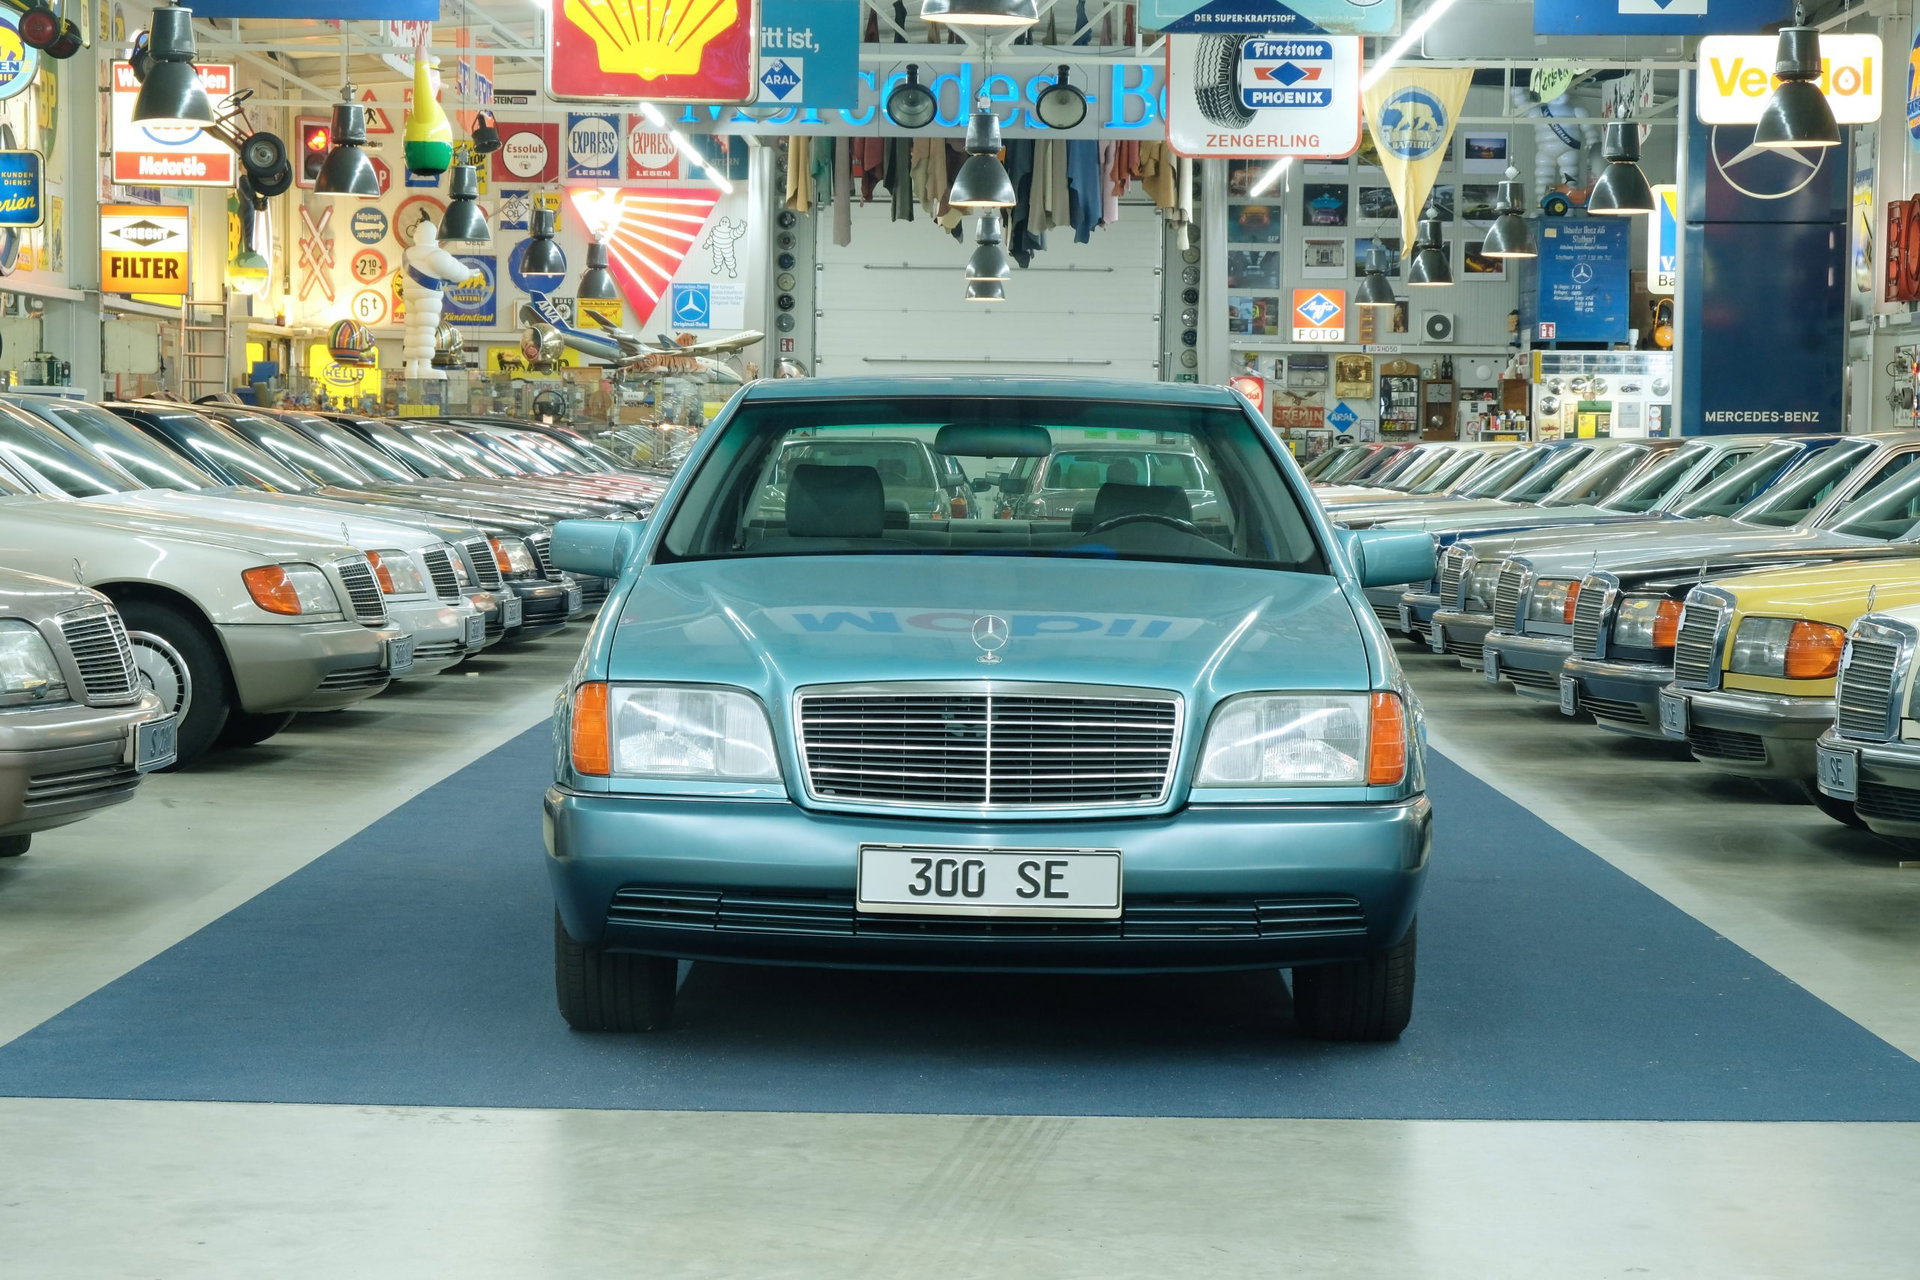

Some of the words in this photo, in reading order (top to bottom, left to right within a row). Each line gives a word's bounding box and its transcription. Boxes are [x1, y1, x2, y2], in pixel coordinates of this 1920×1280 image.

[1194, 14, 1212, 22] DER
[761, 27, 783, 48] itt
[787, 27, 820, 53] ist,
[1253, 41, 1323, 57] Firestone
[765, 75, 796, 85] ARAL
[1709, 57, 1873, 97] Vedol
[1252, 92, 1323, 104] PHOENIX
[506, 144, 545, 153] Essolub
[572, 131, 615, 154] EXPRESS
[632, 132, 675, 155] EXPRESS
[1206, 134, 1320, 148] ZENGERLING
[139, 155, 206, 176] Motoröle
[536, 197, 559, 205] VRTA
[120, 227, 168, 240] KNECHT
[111, 257, 179, 279] FILTER
[360, 259, 367, 275] 2
[360, 297, 369, 317] 6
[535, 300, 560, 324] ANA
[1302, 301, 1335, 320] Agfa
[1298, 329, 1339, 341] FOTO
[1705, 411, 1820, 423] MERCEDES-BENZ
[908, 857, 986, 898] 300
[1016, 860, 1069, 899] SE
